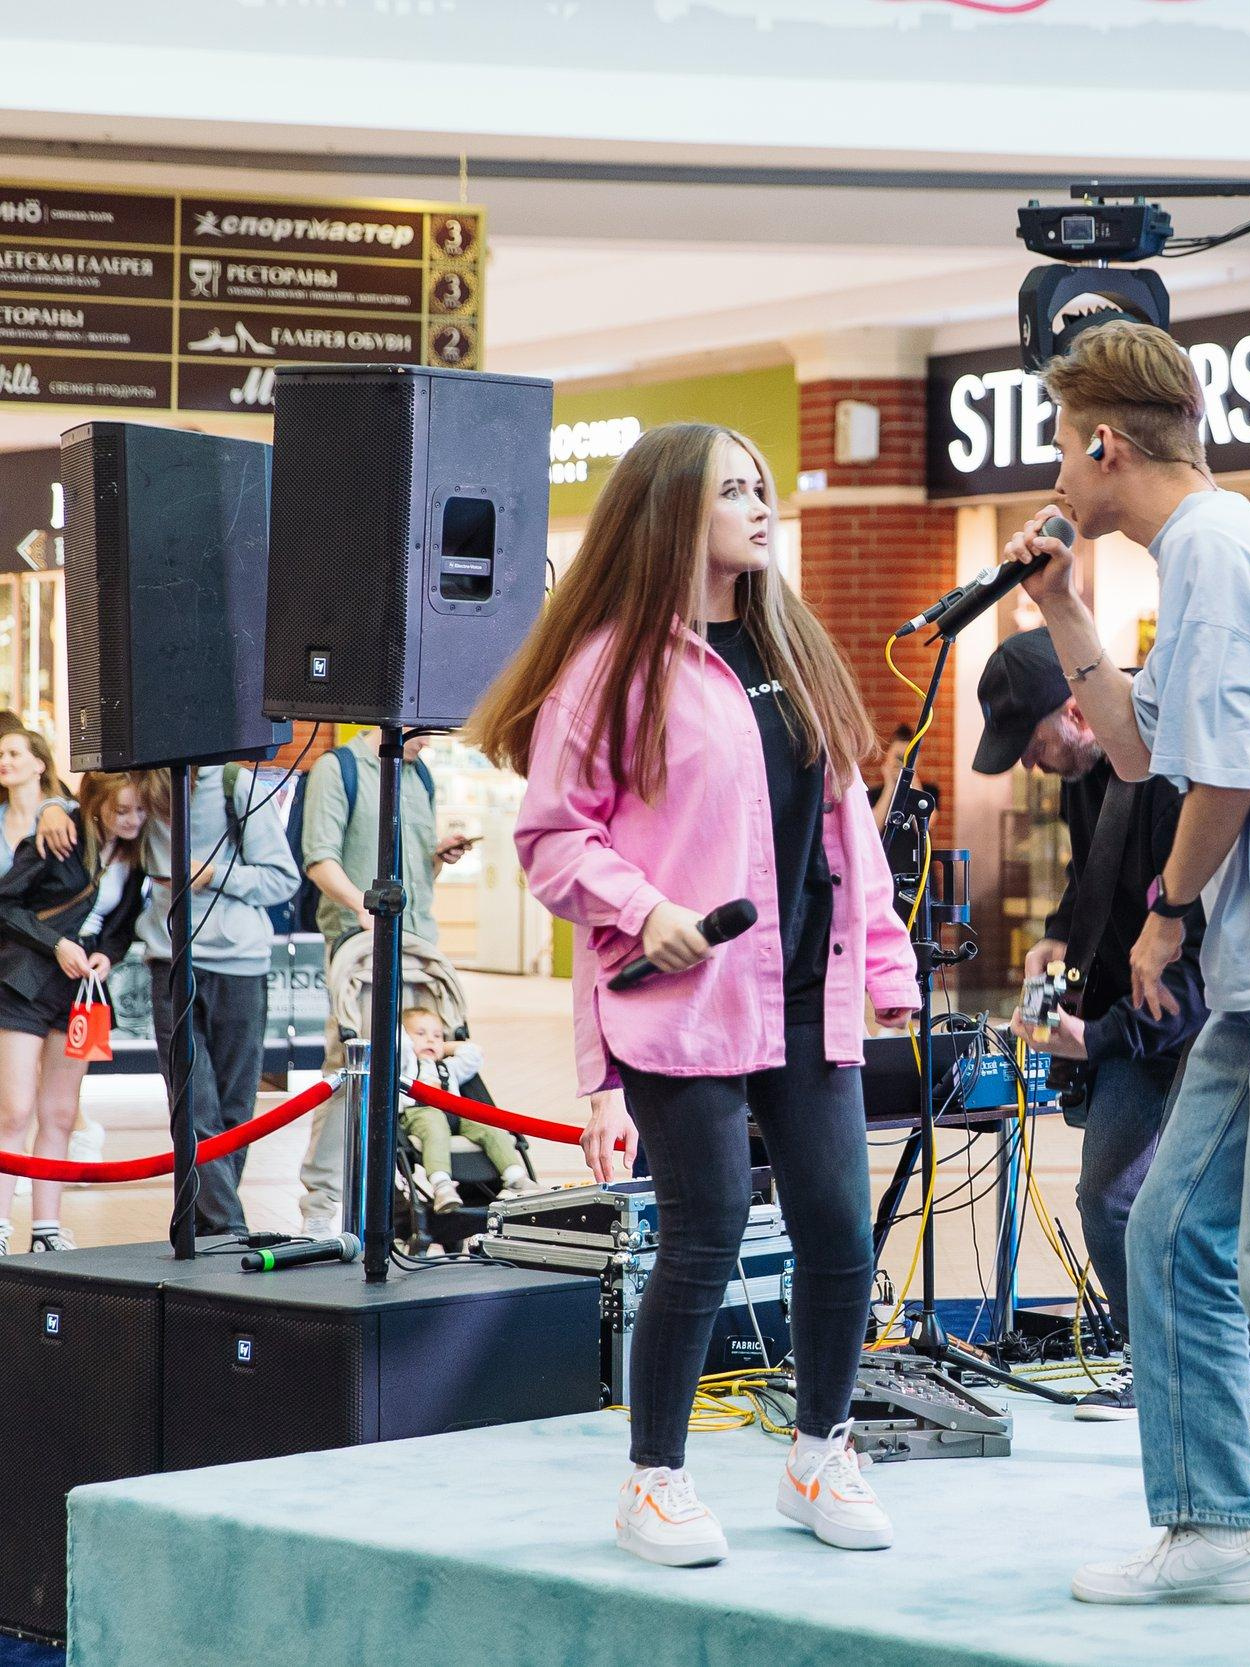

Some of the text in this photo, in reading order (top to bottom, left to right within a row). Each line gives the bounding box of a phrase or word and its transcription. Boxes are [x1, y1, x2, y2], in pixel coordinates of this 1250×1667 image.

[77, 254, 153, 277] ГАЛЕРЕЯ
[227, 263, 338, 288] РЕСТОРАНЫ
[271, 327, 412, 352] ГАЛЕРЕЯ ОБУВИ
